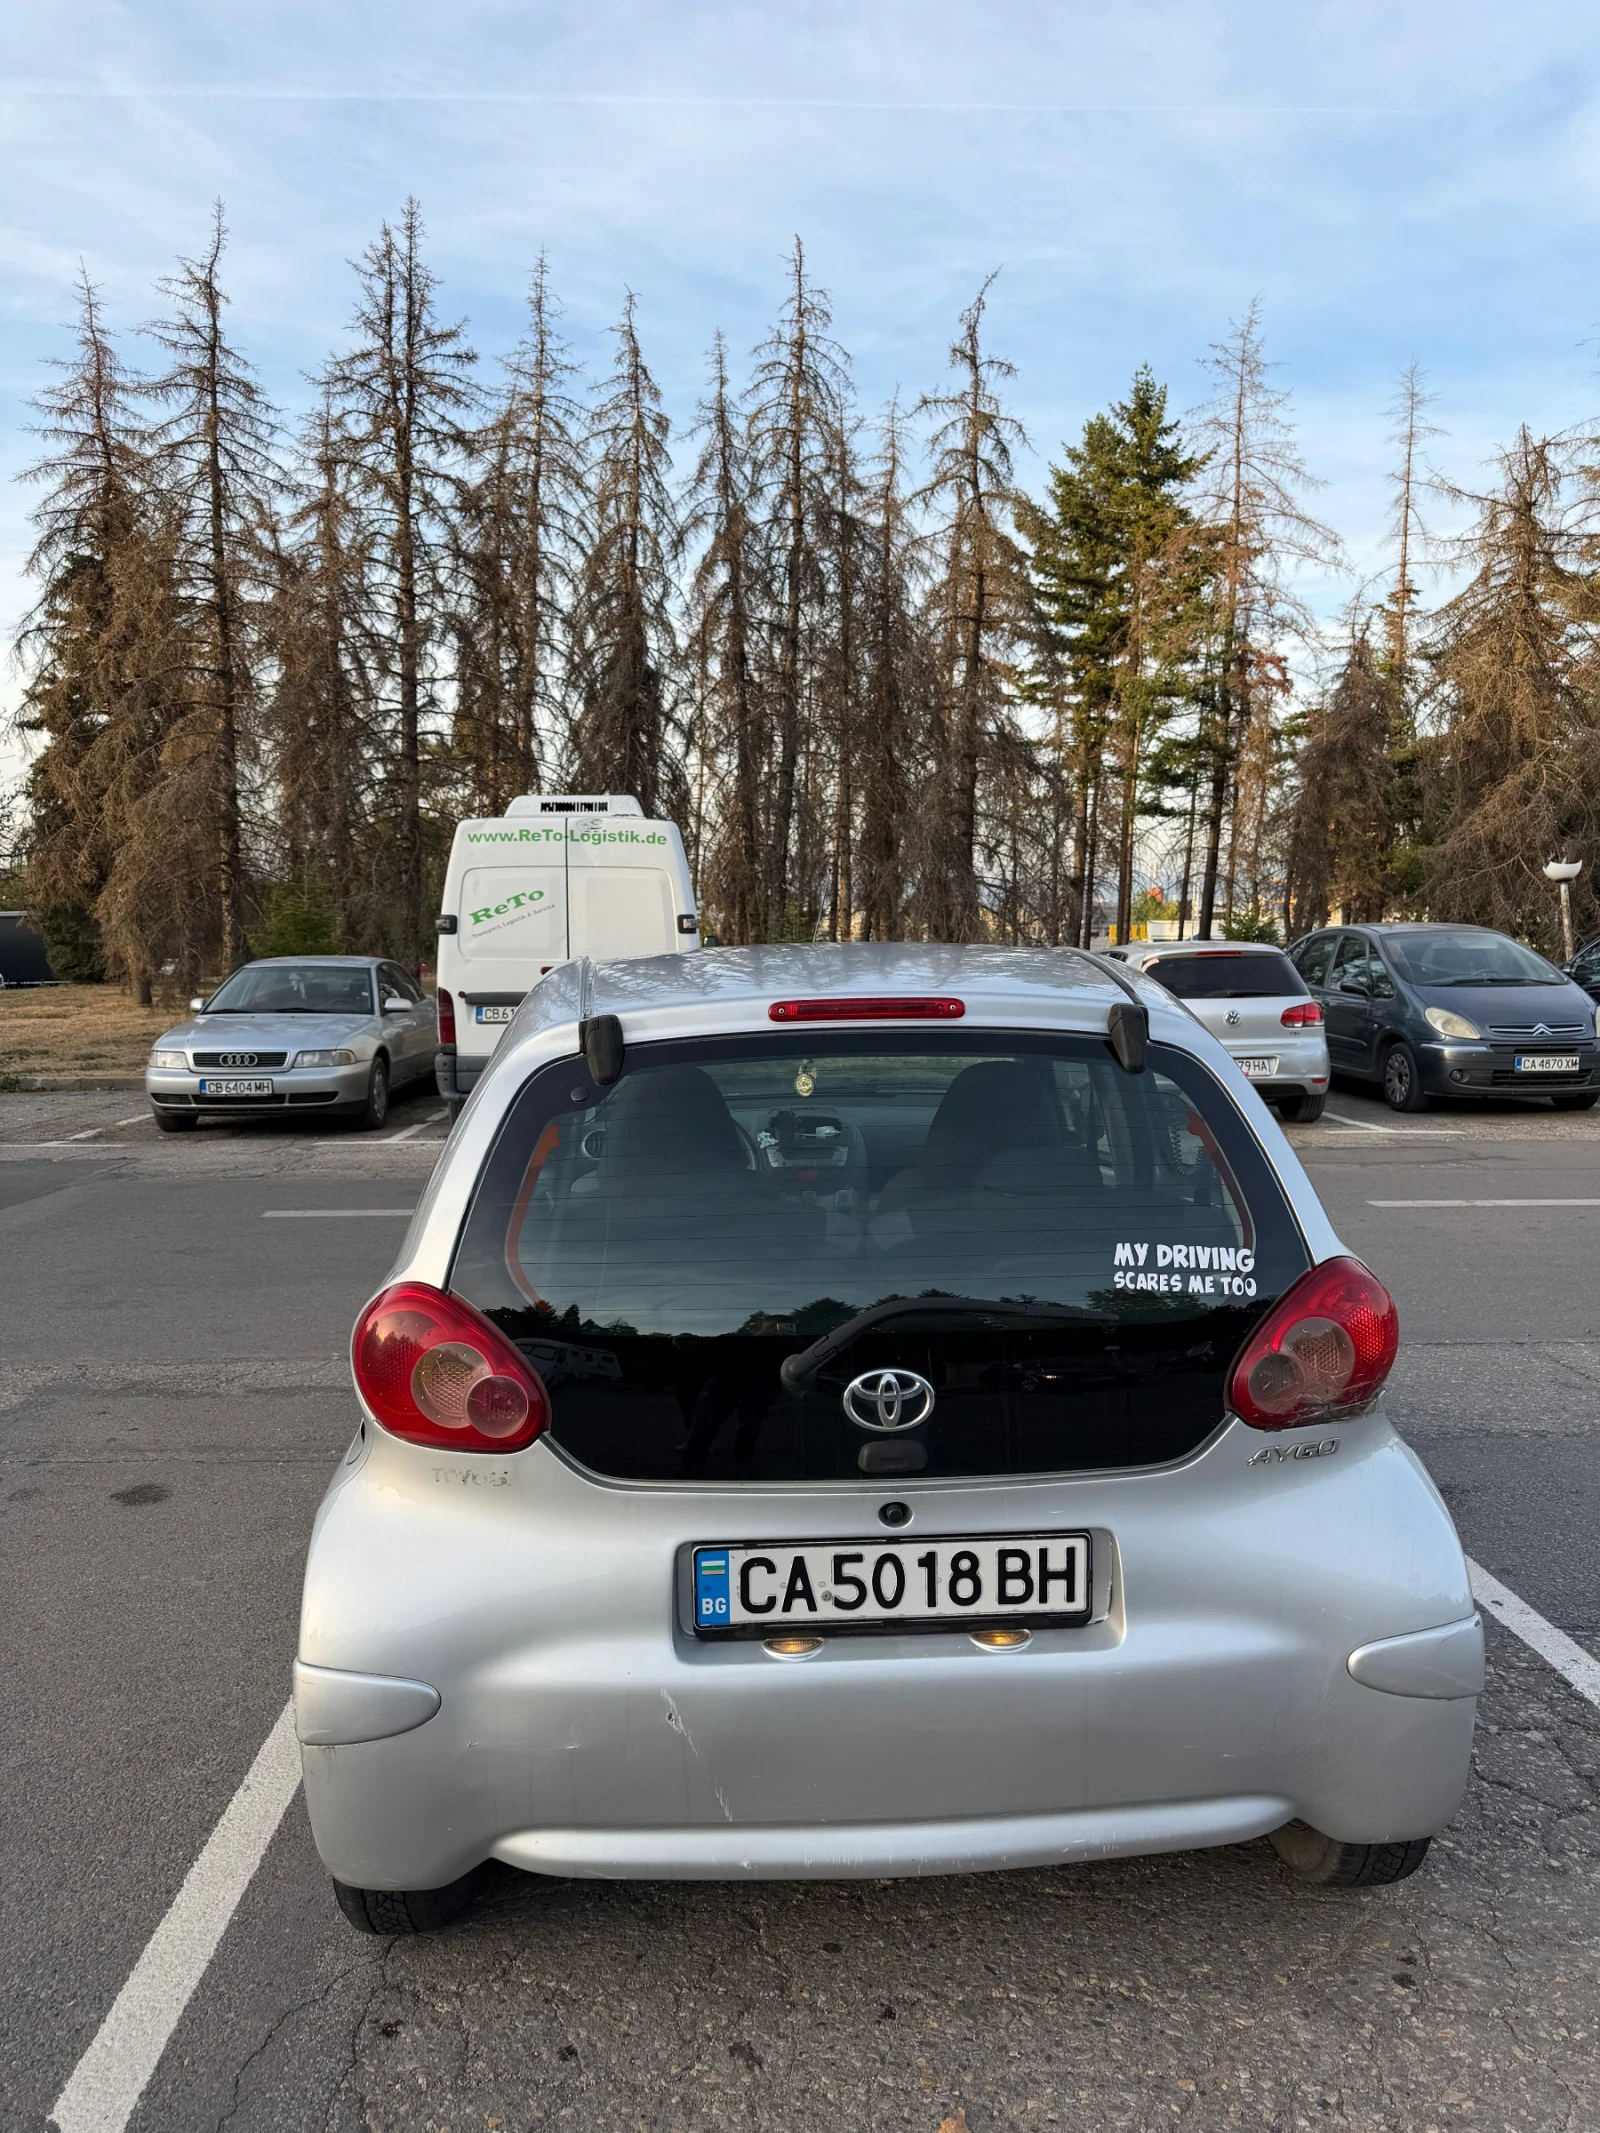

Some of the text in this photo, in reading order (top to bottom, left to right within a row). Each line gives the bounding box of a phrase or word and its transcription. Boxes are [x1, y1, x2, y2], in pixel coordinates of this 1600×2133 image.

[467, 829, 668, 845] www.ReTo-Logistik.de
[468, 890, 544, 926] ReTo
[533, 904, 556, 915] Service
[1113, 1243, 1255, 1273] MY DRIVING
[1113, 1271, 1257, 1297] SCARES ME TOO
[1246, 1437, 1340, 1466] AYGO
[701, 1597, 727, 1615] BG
